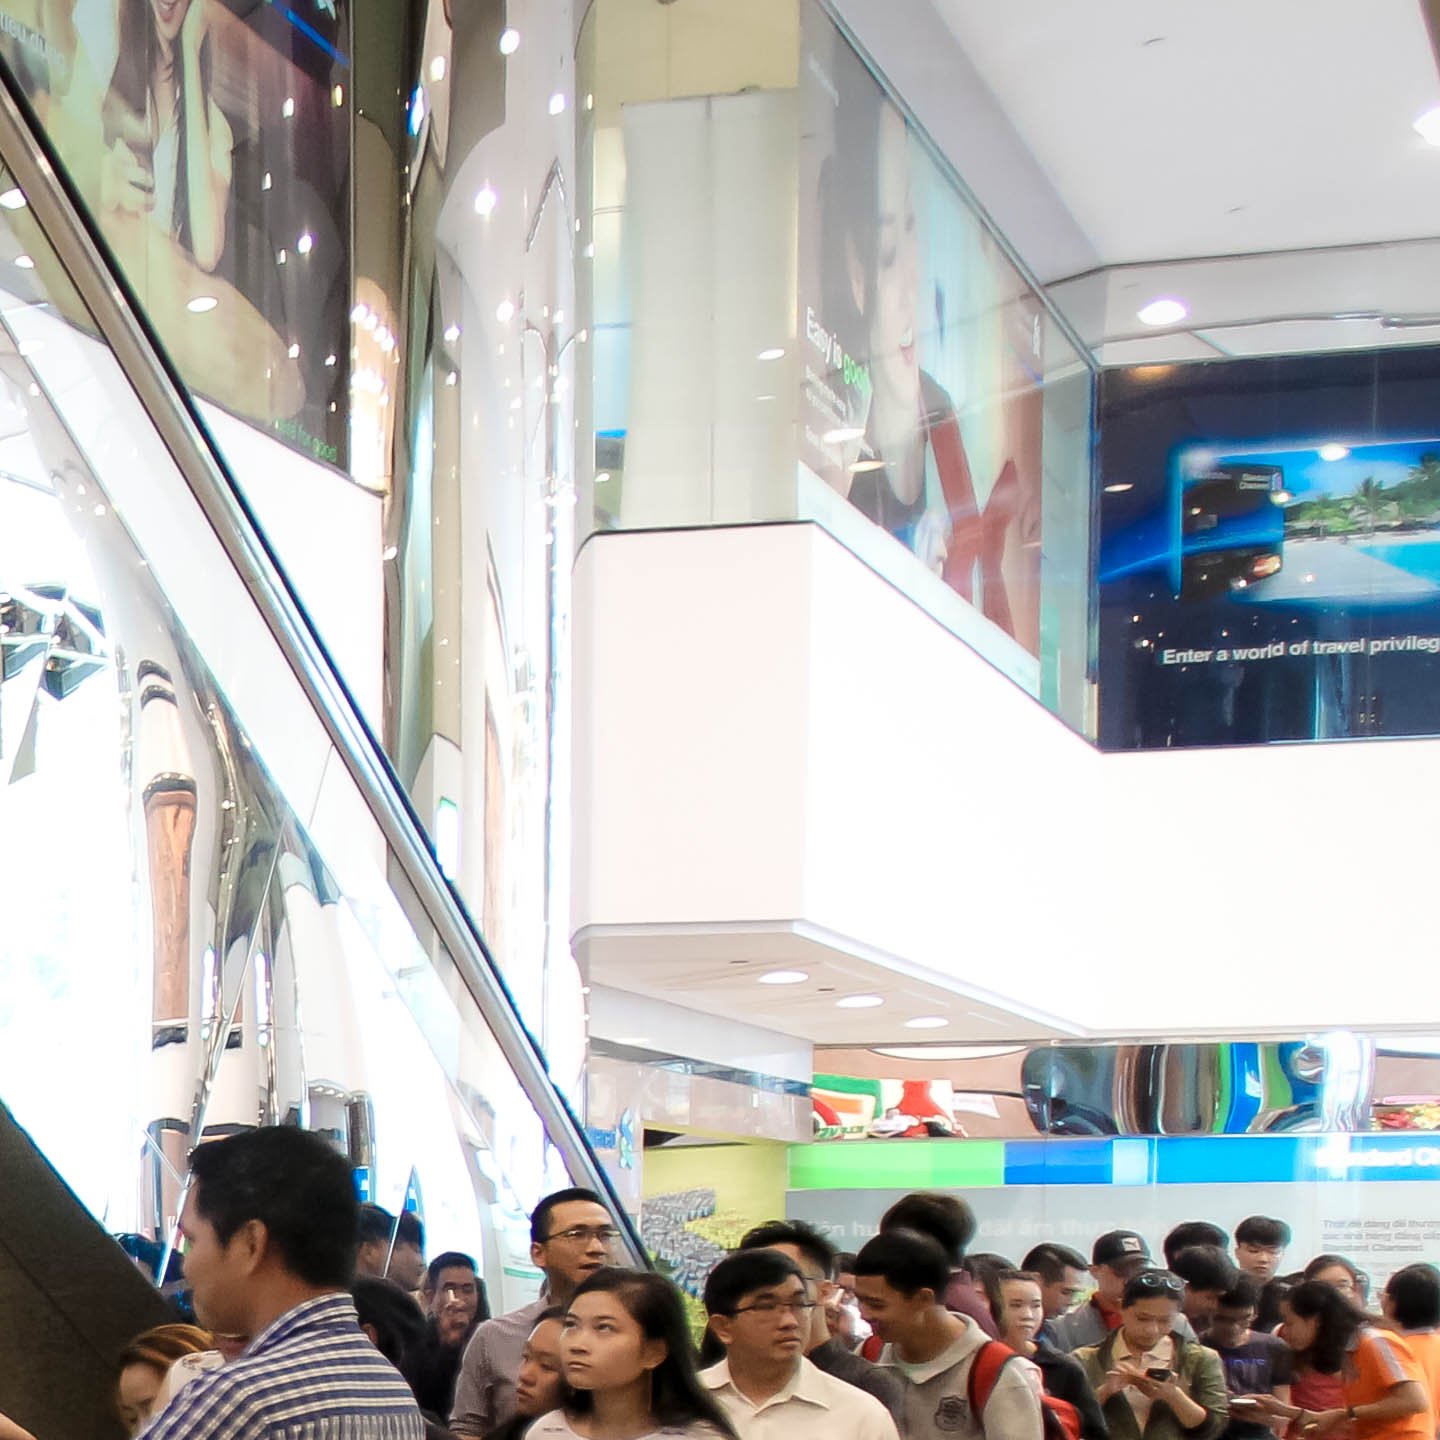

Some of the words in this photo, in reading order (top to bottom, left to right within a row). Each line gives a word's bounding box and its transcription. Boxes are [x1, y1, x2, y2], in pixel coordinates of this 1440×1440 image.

[1163, 648, 1212, 665] Enter
[1216, 650, 1229, 662] a
[1231, 641, 1285, 662] world
[1289, 639, 1310, 657] of
[1312, 637, 1365, 656] travel
